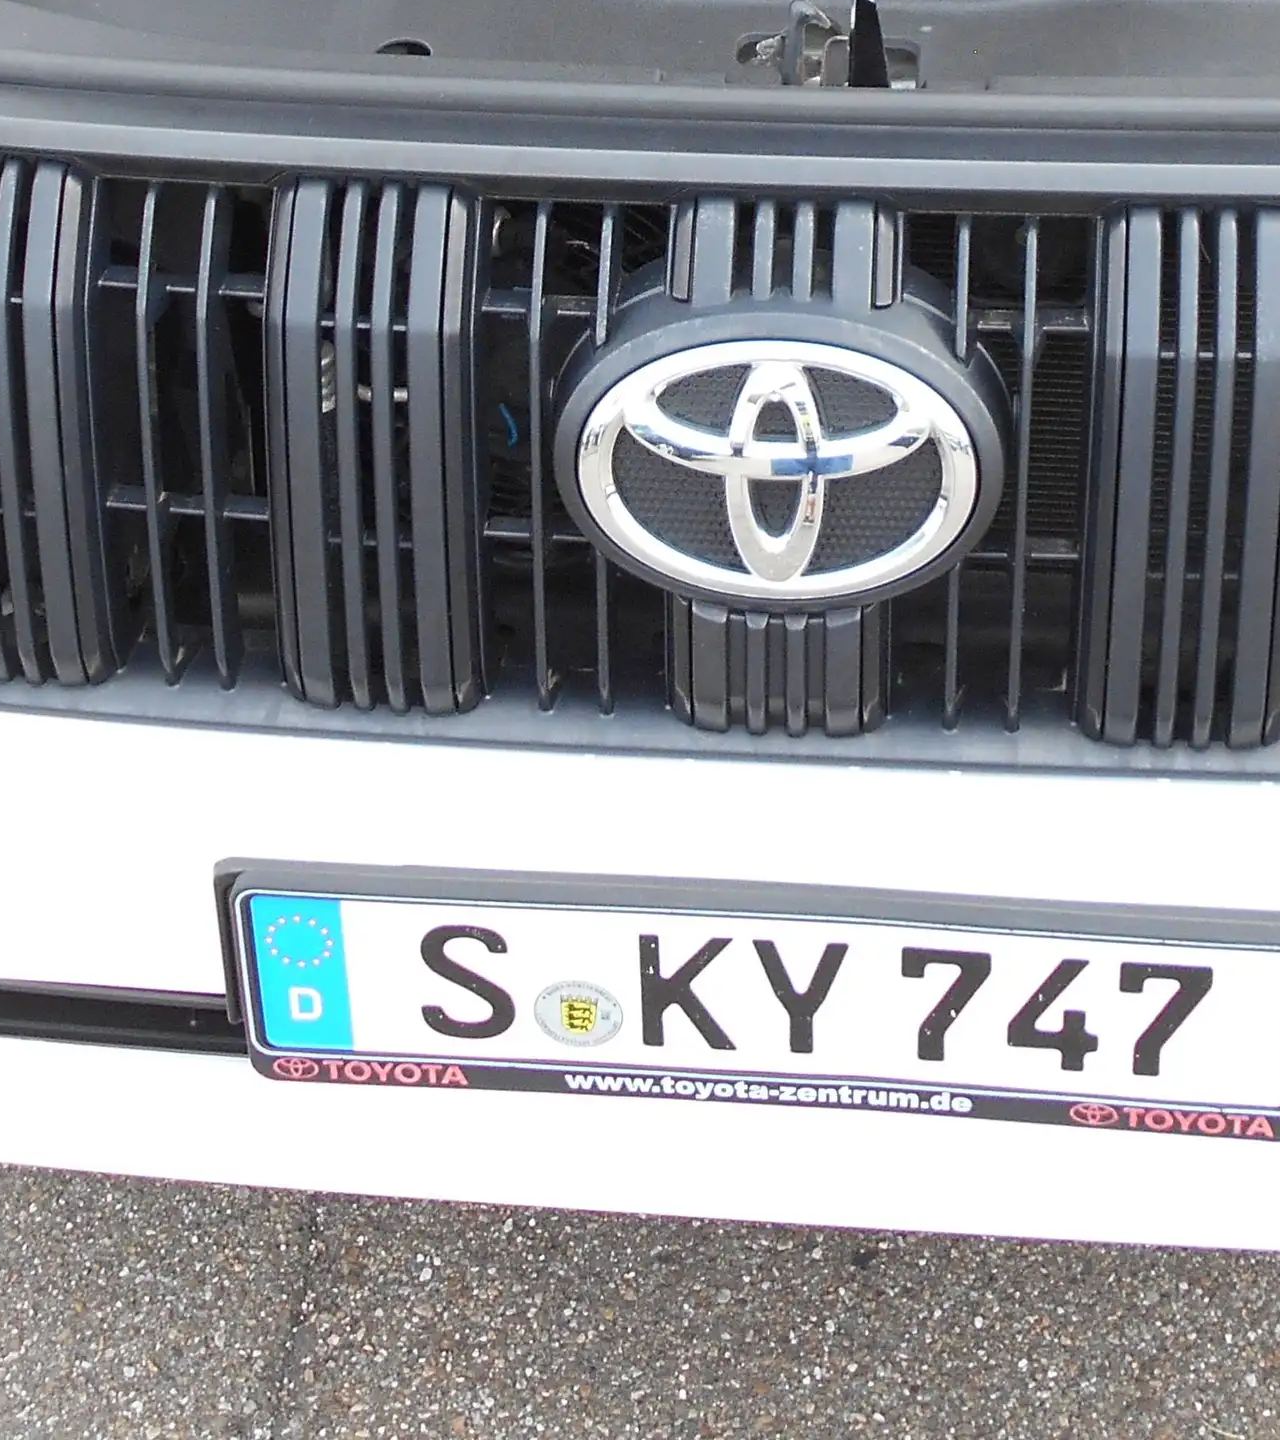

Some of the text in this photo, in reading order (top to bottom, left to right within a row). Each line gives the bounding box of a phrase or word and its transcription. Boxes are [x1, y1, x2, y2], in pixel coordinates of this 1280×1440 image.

[288, 986, 323, 1021] D
[420, 924, 1214, 1077] S KY 747
[322, 1059, 469, 1086] TOYOTA
[564, 1073, 973, 1113] www.toyota-zentrum.de
[1124, 1106, 1275, 1139] TOYOTA
